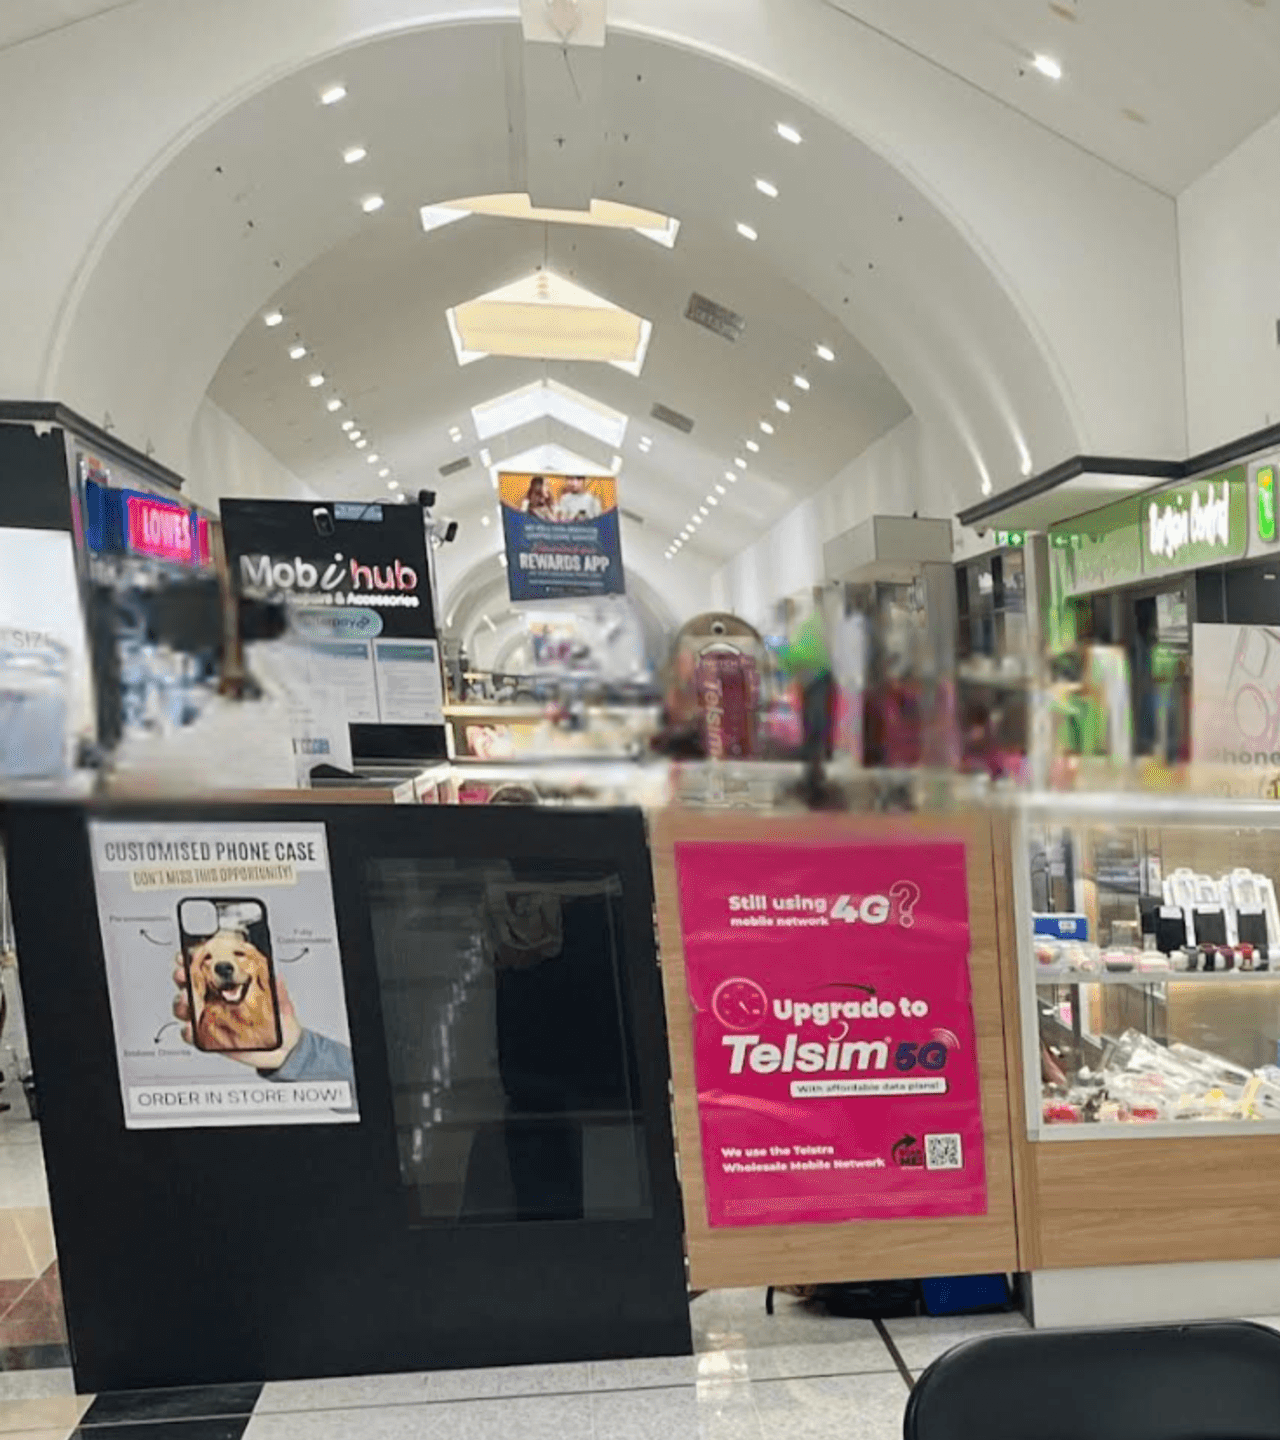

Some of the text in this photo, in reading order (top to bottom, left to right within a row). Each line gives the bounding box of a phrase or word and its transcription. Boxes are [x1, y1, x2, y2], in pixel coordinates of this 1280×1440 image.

[519, 552, 610, 573] REWARDS APP
[104, 841, 317, 863] CUSTOMISED PHONE CASE
[133, 864, 294, 887] DON'T MISS THIS OPPORTUNITY!
[728, 894, 768, 911] Still
[772, 894, 828, 914] using
[730, 915, 830, 927] mobile network
[772, 996, 929, 1027] Upgrade to
[721, 1032, 889, 1075] Telsim
[137, 1087, 344, 1107] ORDER IN STORE NOW!
[720, 1145, 835, 1158] We use the Telstra
[722, 1160, 788, 1173] Wholesale
[789, 1158, 831, 1171] Mobile
[833, 1157, 886, 1169] Network
